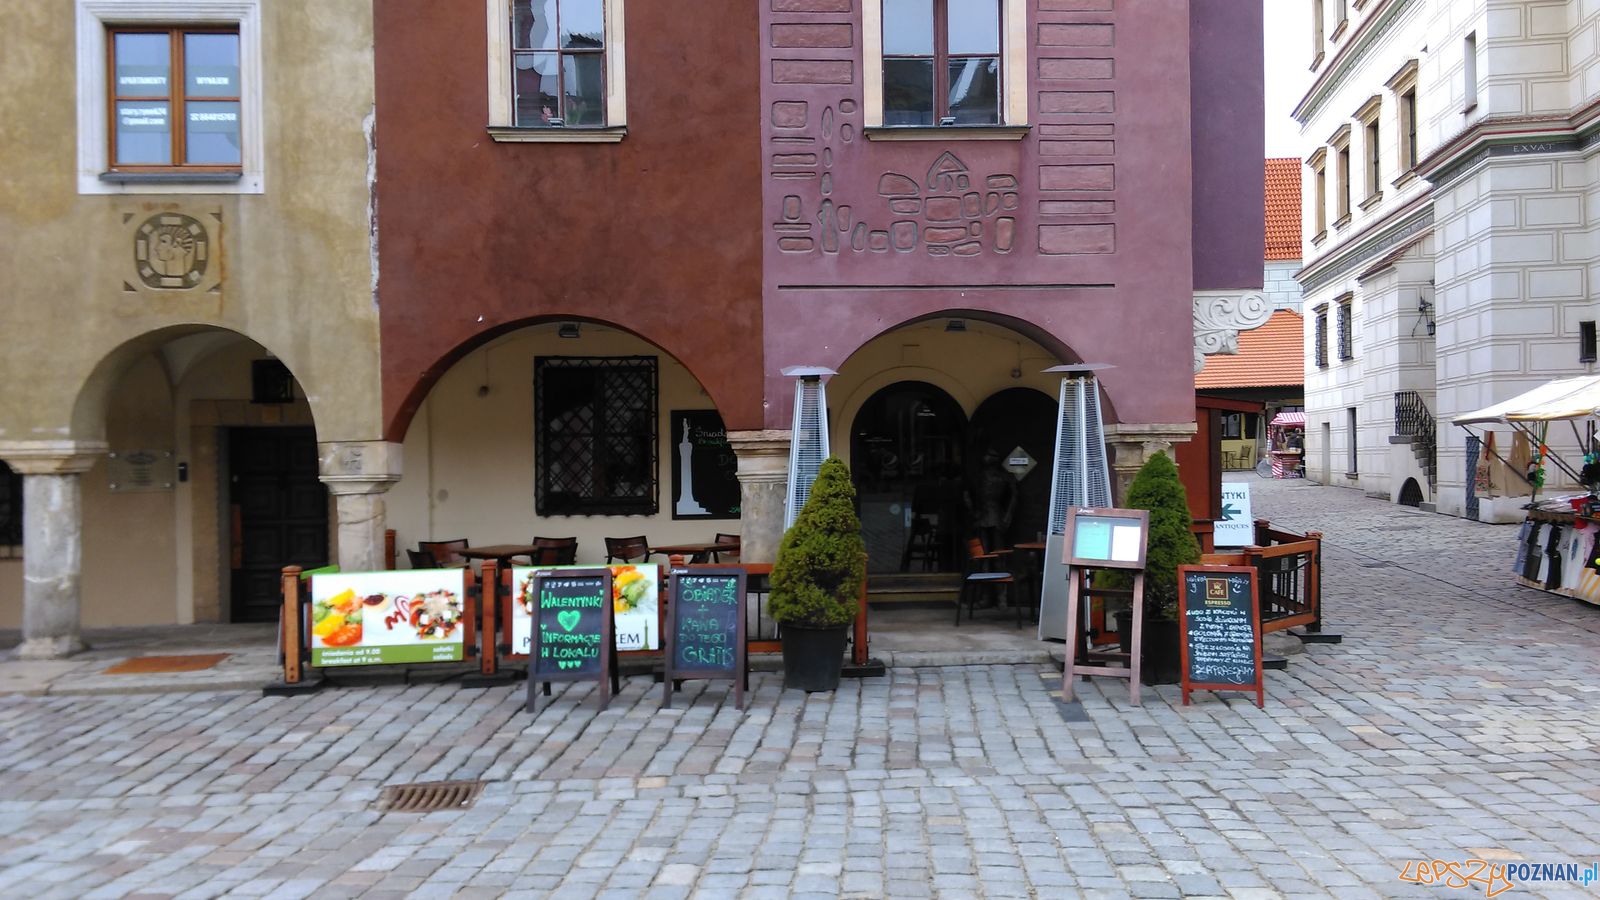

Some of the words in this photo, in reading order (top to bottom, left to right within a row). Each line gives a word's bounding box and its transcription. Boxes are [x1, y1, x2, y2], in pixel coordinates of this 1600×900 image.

[1513, 143, 1554, 153] EXVAT
[541, 590, 604, 608] WALENTYNKI
[682, 617, 719, 632] KAWA
[541, 632, 601, 646] INFORMACJE
[355, 648, 365, 656] od
[553, 647, 598, 658] LOKALU
[682, 646, 736, 666] GRATIS
[321, 657, 353, 665] breakfast
